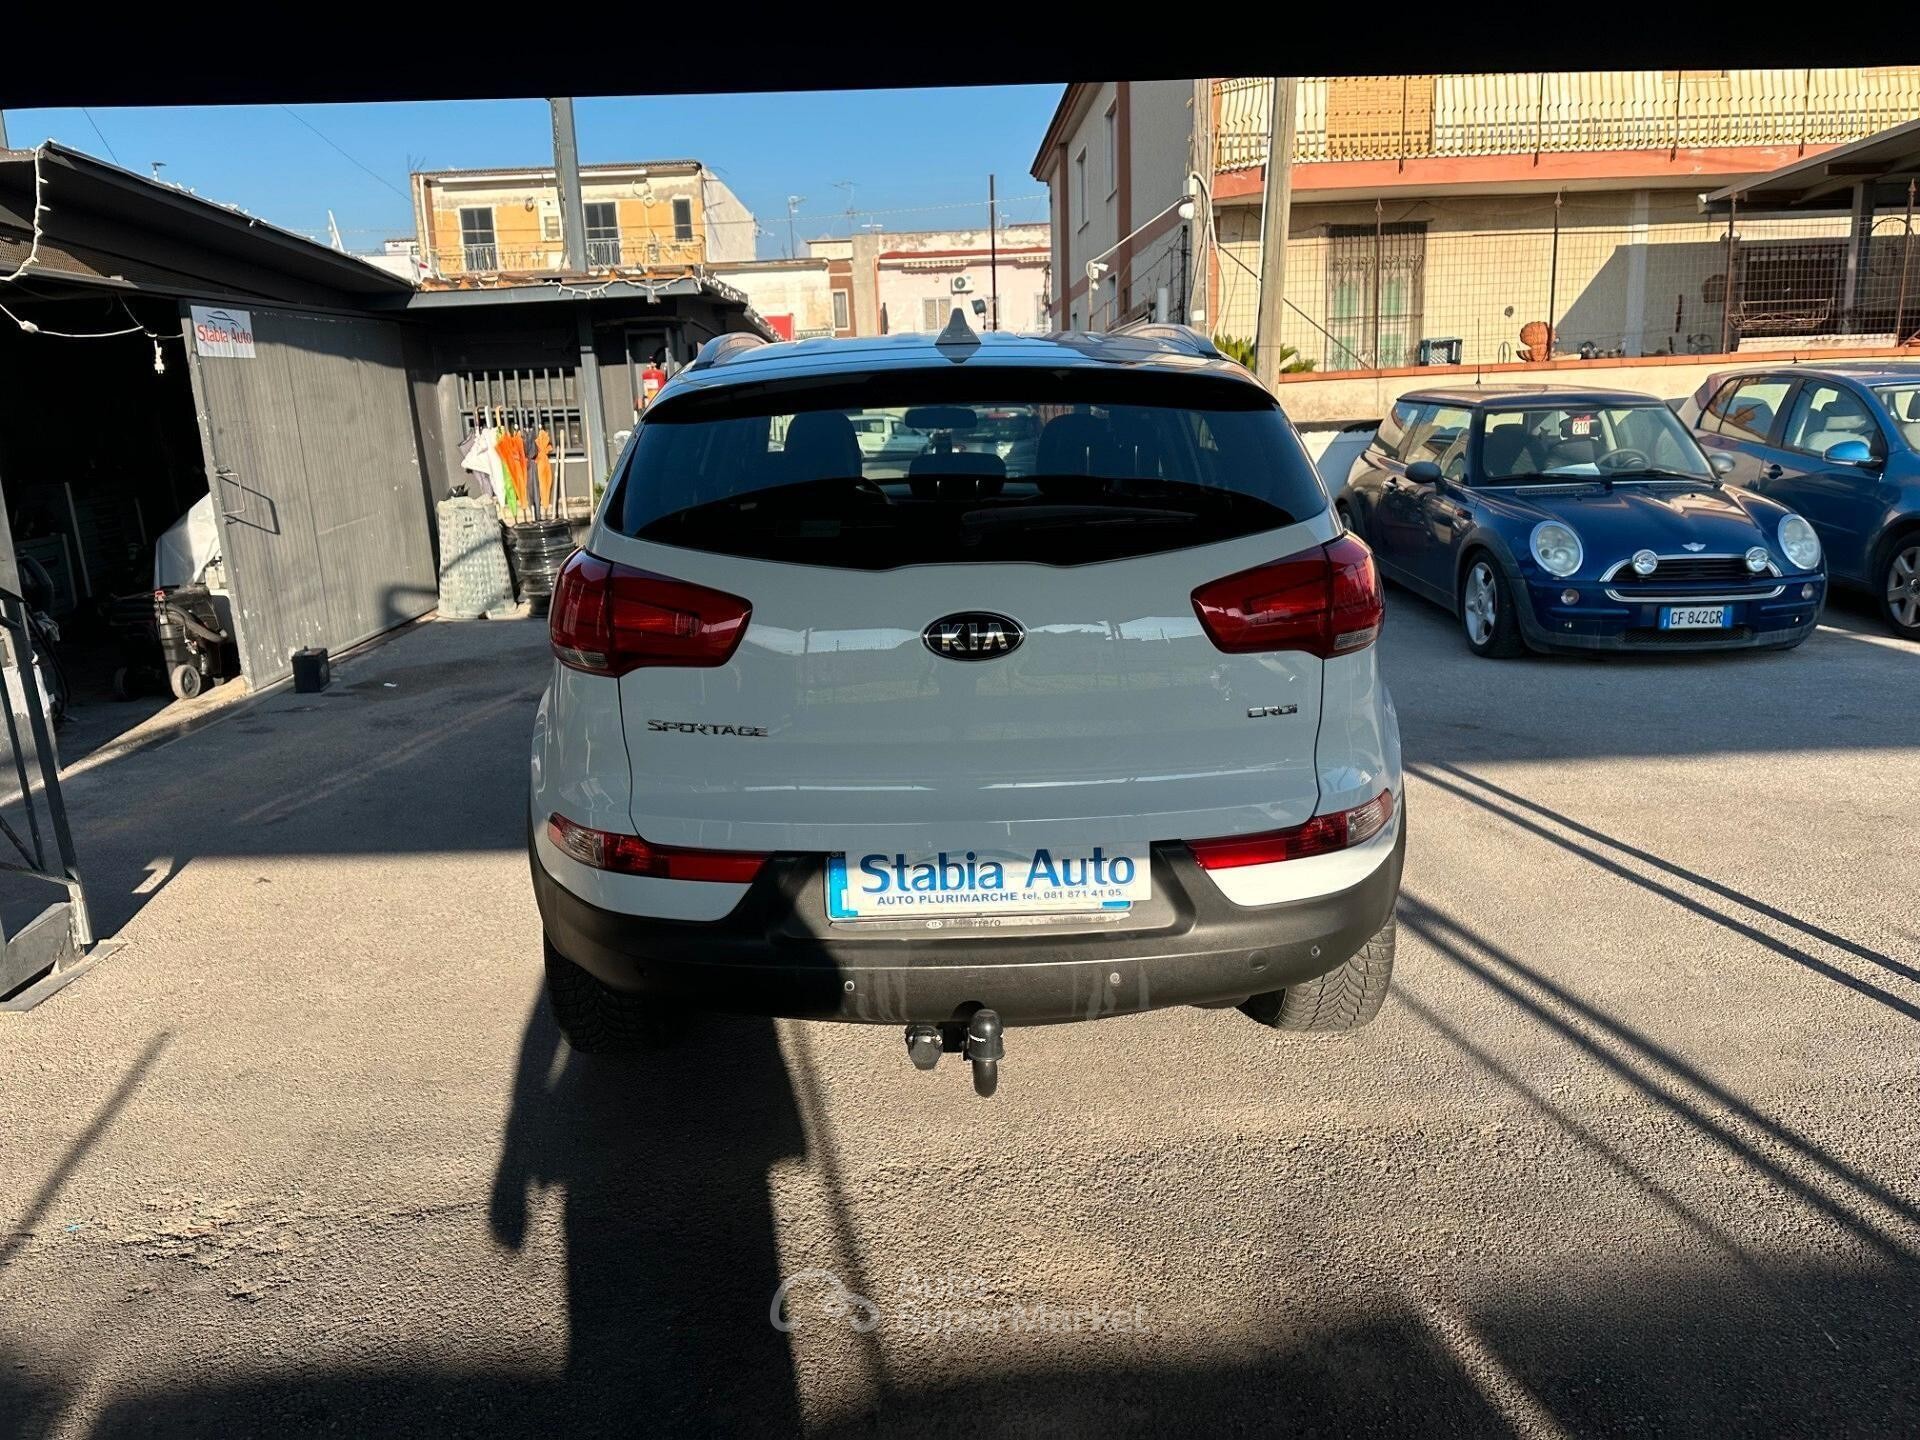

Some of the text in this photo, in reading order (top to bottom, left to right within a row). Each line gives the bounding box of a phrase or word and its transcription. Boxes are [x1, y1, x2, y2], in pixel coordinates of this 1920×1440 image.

[197, 324, 252, 344] Stabia Auto
[1574, 422, 1588, 434] 210
[1671, 611, 1685, 625] CF
[941, 623, 1008, 650] KIA
[647, 719, 769, 737] SPORTAGE
[859, 847, 1135, 893] Stabia Auto
[877, 895, 914, 906] AUTO
[919, 891, 1018, 904] PLURIMARCHE
[1043, 890, 1063, 899] 081
[1068, 889, 1087, 898] 871
[1090, 889, 1104, 897] 41
[1107, 888, 1122, 896] 05
